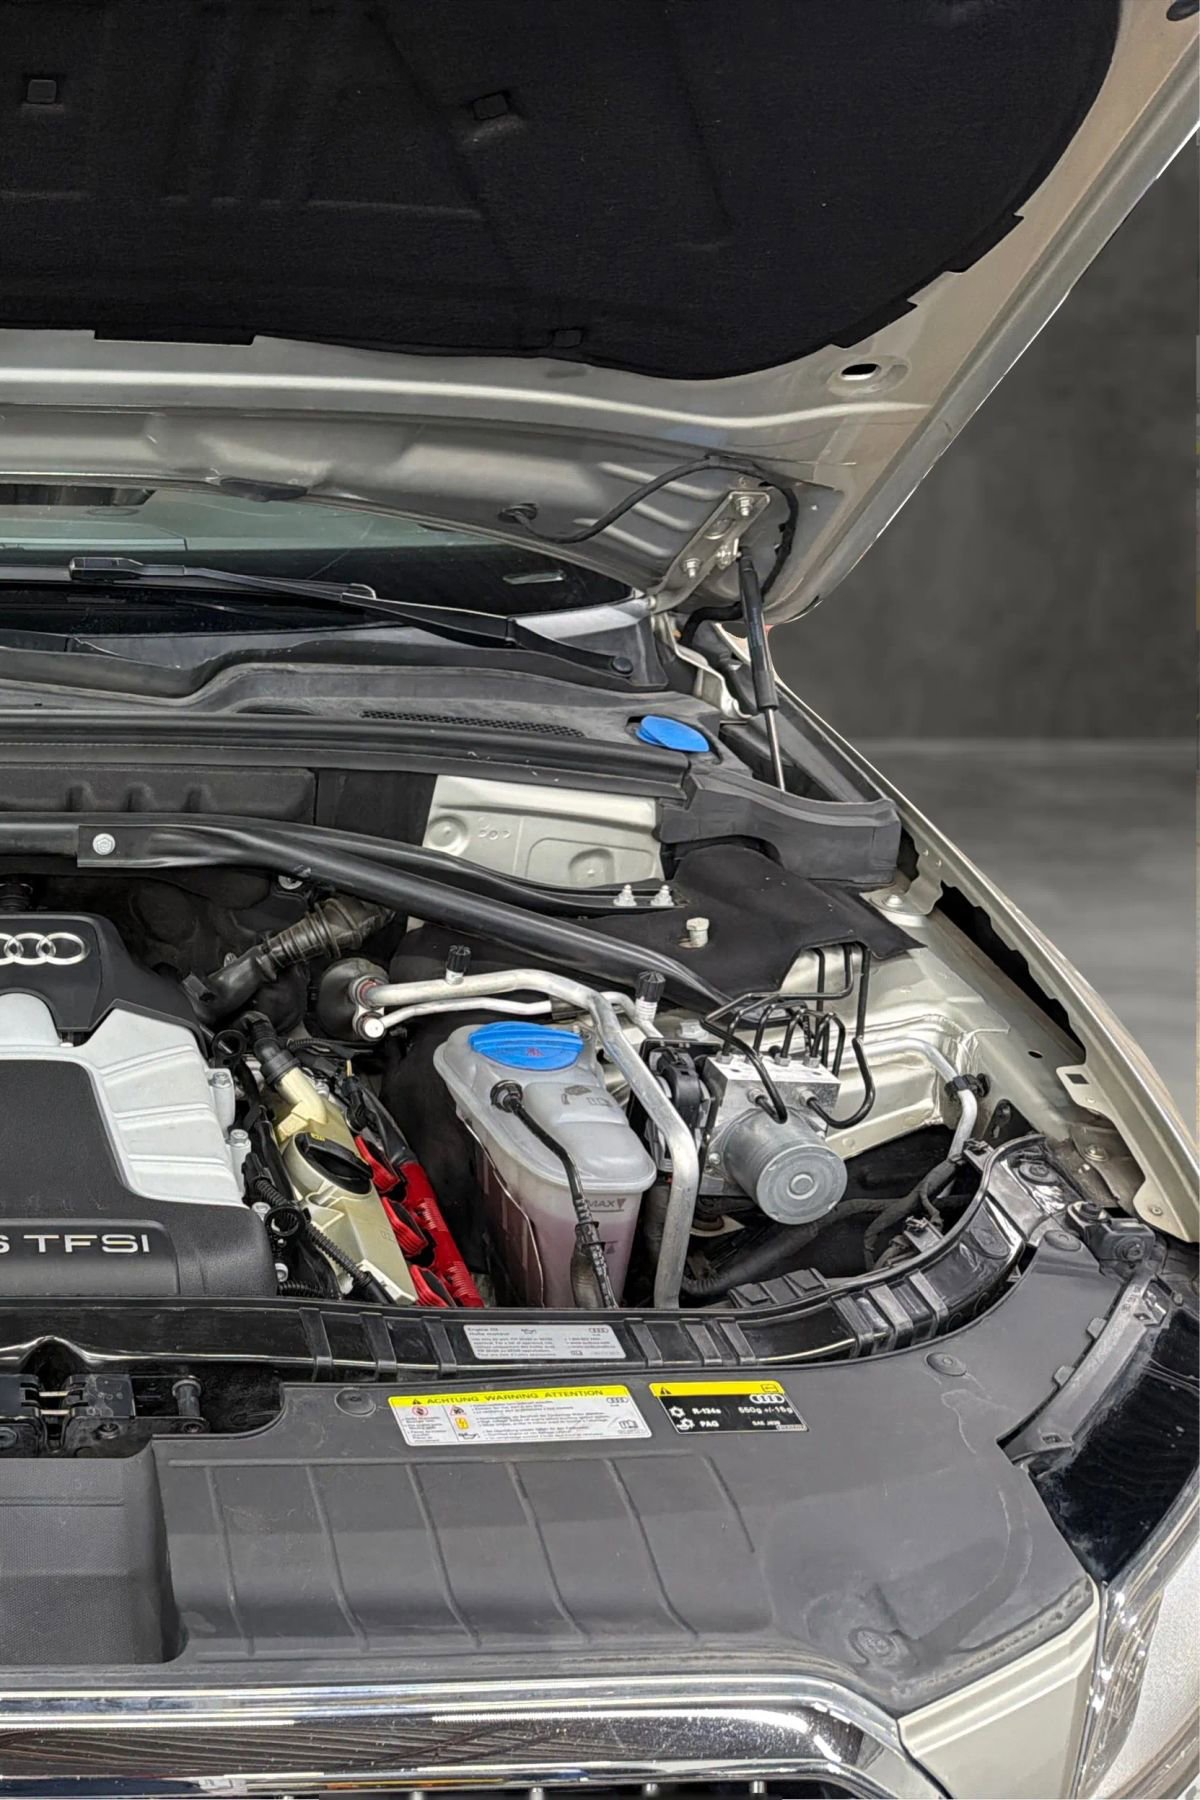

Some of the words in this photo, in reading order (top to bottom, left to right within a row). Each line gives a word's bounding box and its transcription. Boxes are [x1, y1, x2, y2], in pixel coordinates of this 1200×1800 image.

[23, 1234, 150, 1254] TFSI
[427, 1396, 480, 1404] ACHTUNG
[483, 1393, 539, 1402] WARNING
[544, 1390, 604, 1398] ATTENTION
[699, 1420, 720, 1428] PAG
